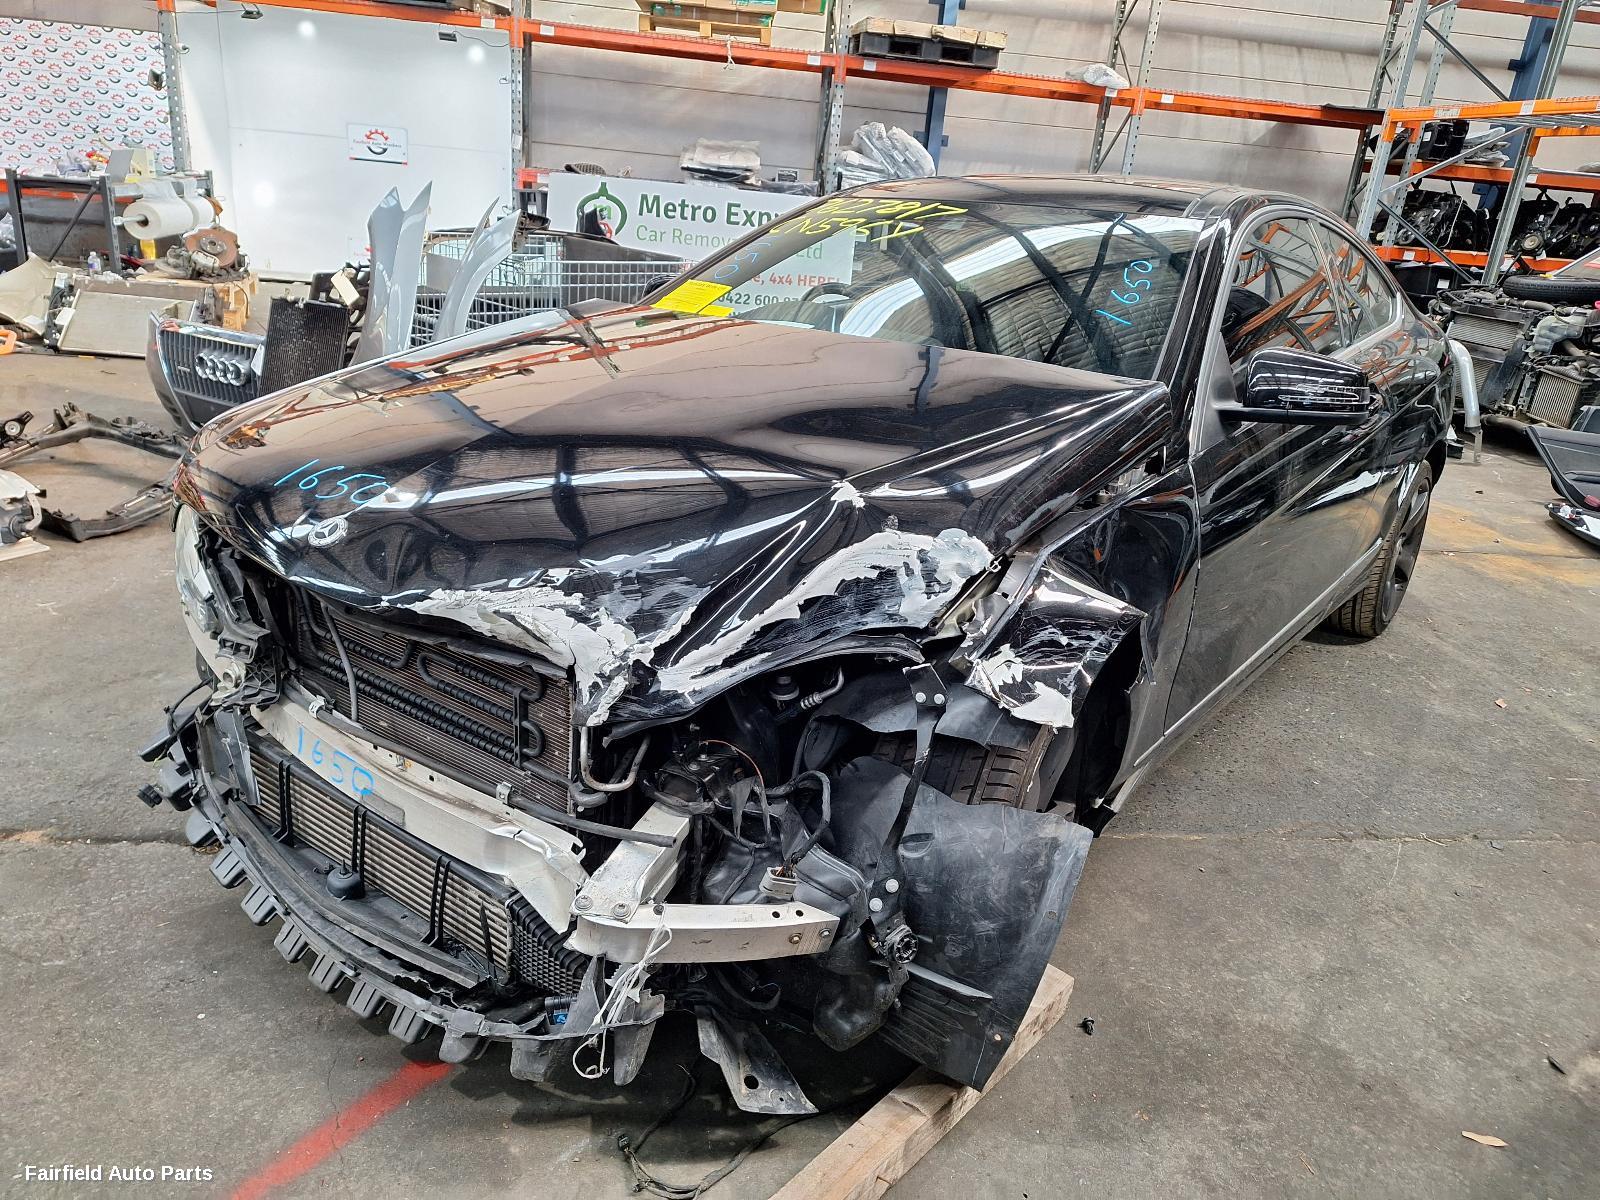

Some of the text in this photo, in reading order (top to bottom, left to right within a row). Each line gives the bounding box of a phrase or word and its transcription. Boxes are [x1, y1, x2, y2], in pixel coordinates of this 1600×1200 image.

[638, 194, 717, 224] Metro
[636, 224, 736, 248] Car Remov
[769, 272, 793, 286] 4x4
[1095, 260, 1153, 326] 1650
[273, 458, 391, 505] 1650
[297, 727, 376, 796] 1650
